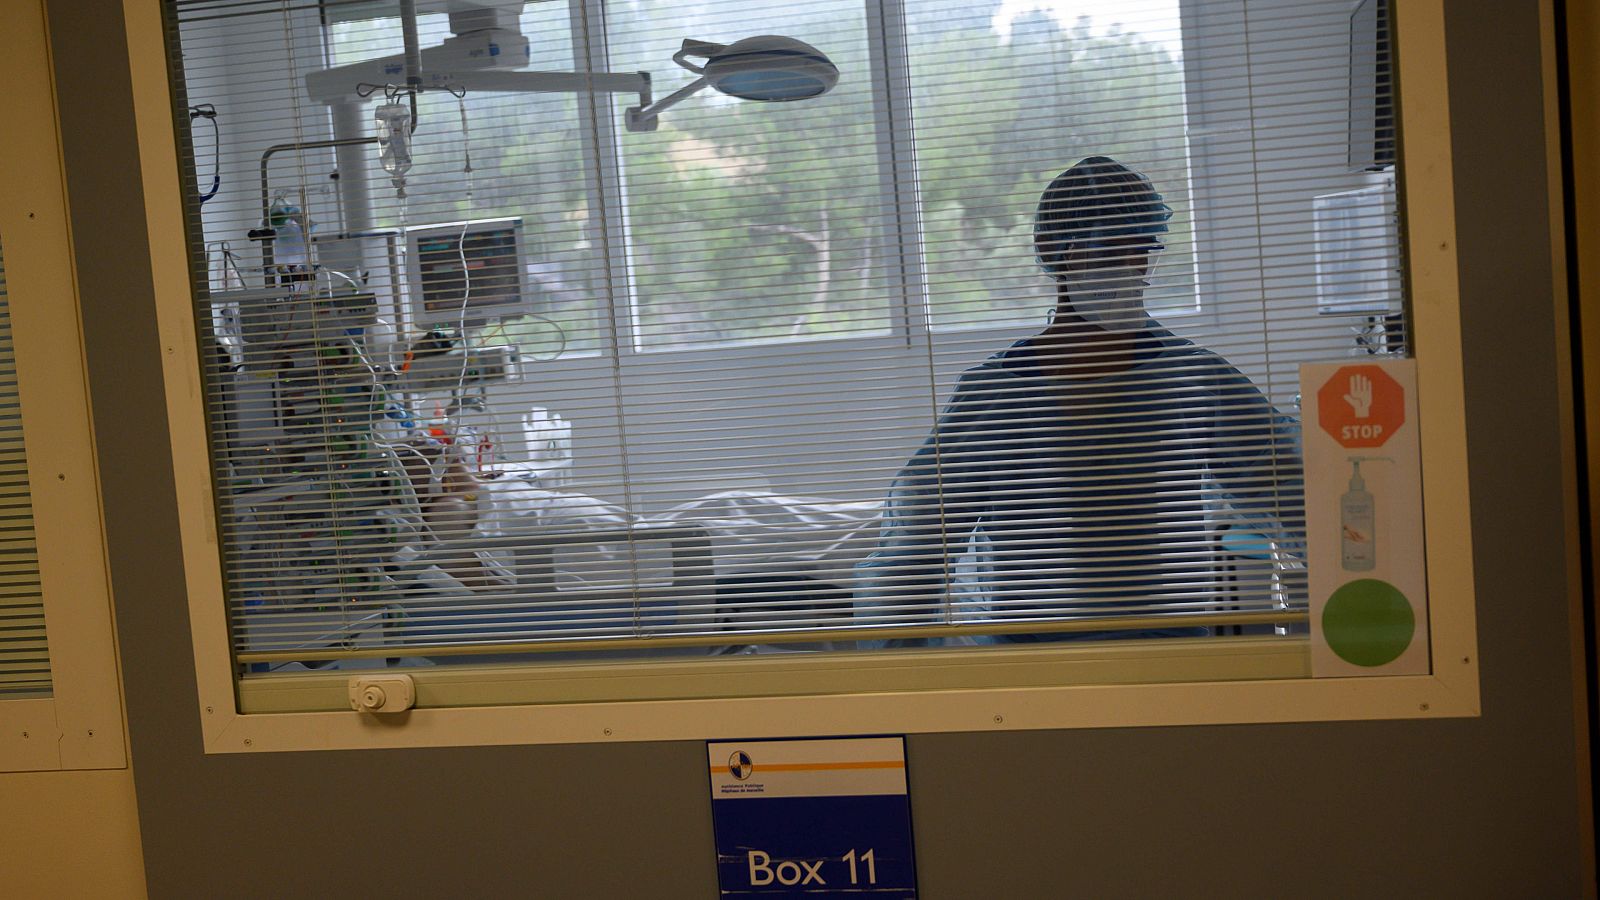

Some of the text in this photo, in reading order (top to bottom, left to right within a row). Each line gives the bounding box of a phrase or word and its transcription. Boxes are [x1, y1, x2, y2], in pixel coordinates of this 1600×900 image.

[1342, 424, 1383, 440] STOP
[748, 848, 876, 886] Box 11
